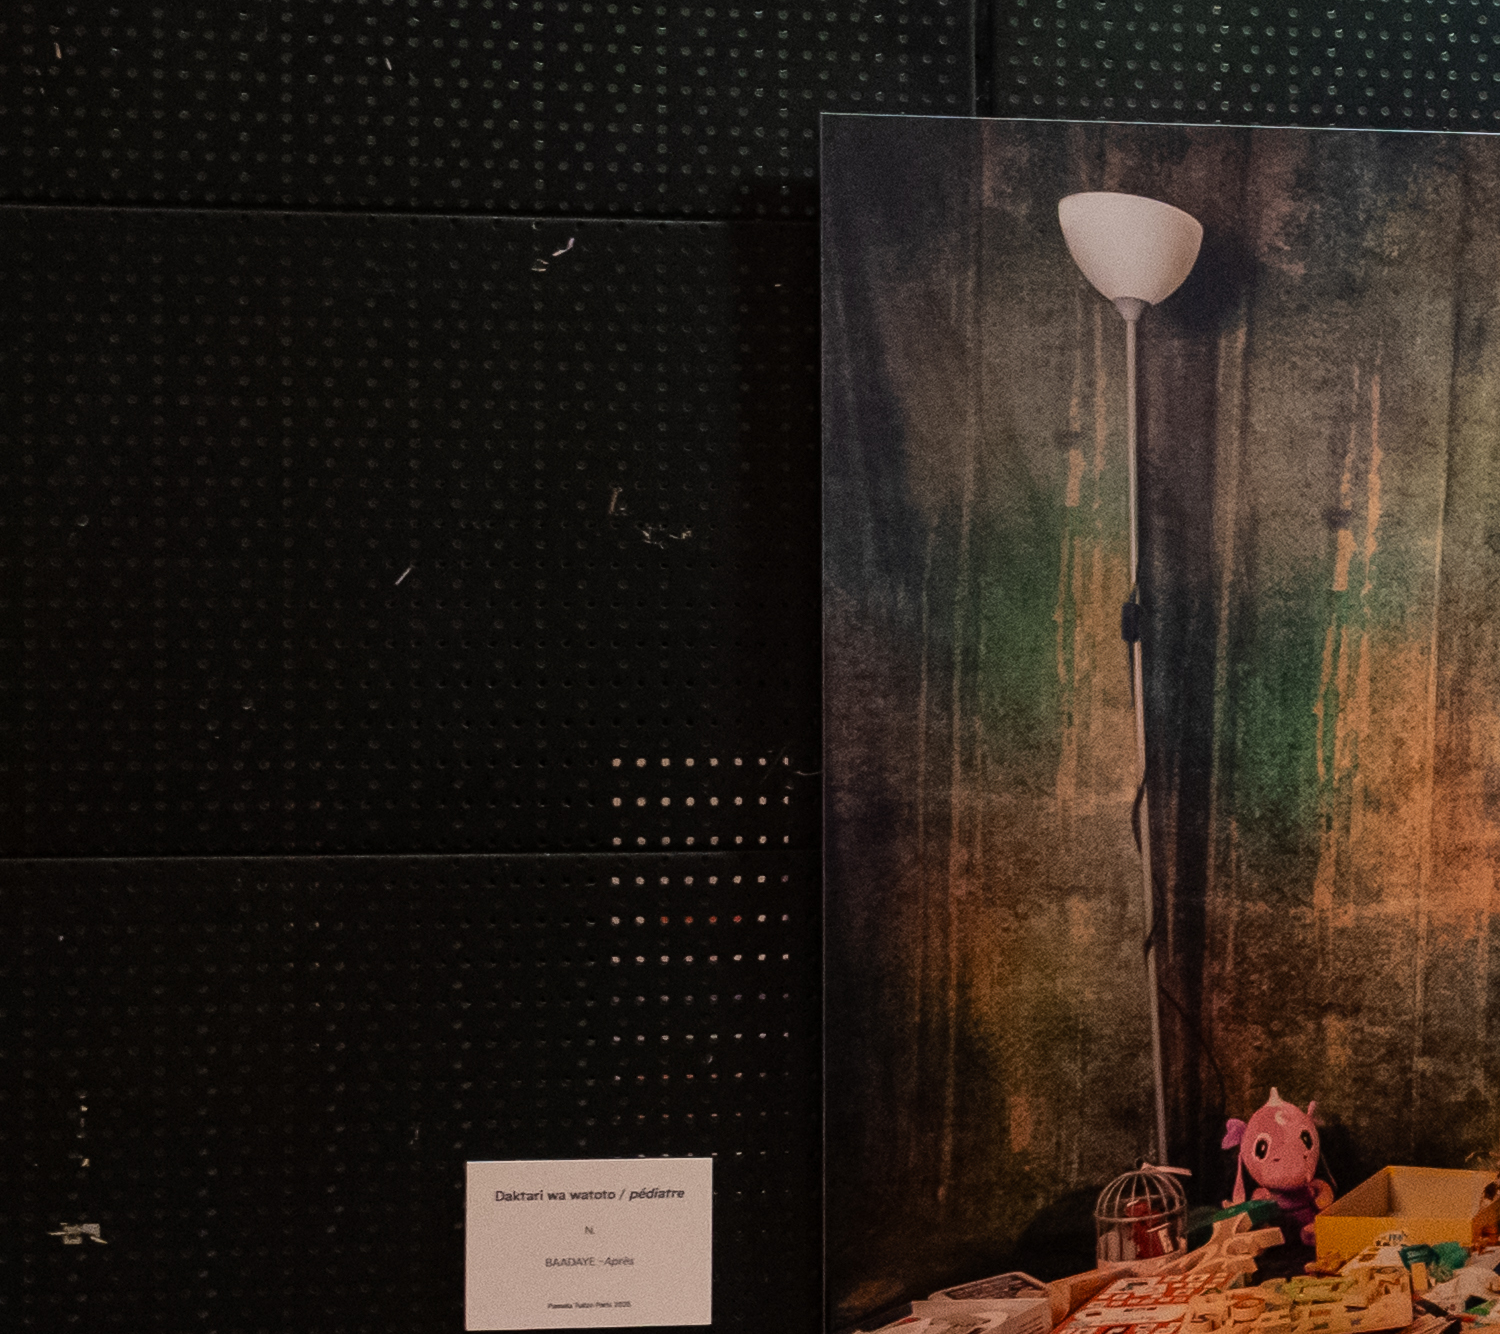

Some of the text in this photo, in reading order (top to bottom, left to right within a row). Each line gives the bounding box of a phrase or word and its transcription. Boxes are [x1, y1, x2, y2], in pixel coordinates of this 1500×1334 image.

[495, 1187, 685, 1202] Daktari wa watoto / pédiatre
